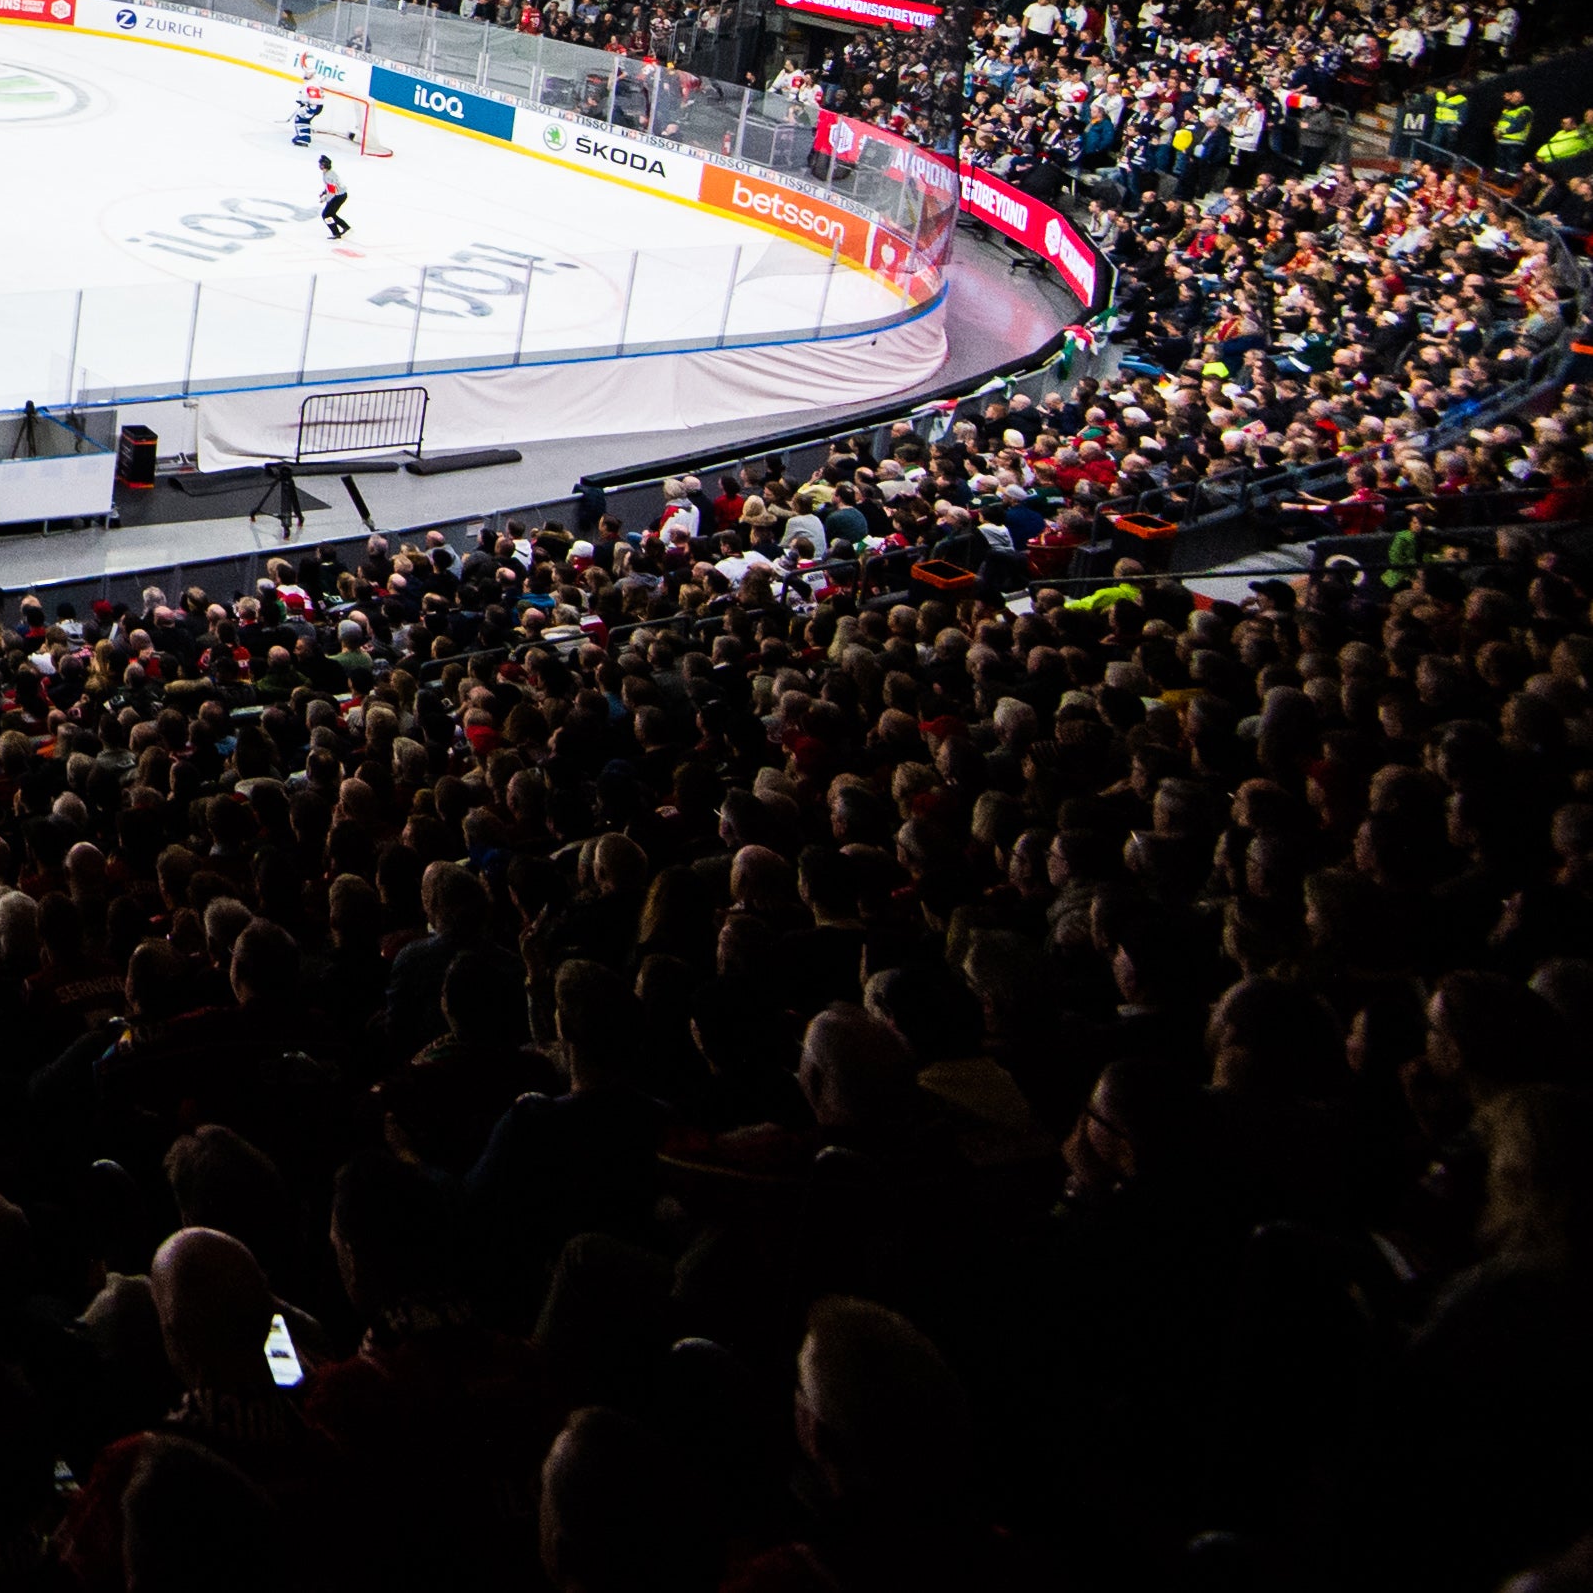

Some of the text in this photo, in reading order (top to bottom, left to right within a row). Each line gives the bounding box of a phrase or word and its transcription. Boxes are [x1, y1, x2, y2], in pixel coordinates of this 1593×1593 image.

[155, 2, 191, 15] TISSOT
[212, 12, 243, 26] TISSOT
[145, 17, 204, 39] ZURICH
[354, 49, 386, 66] TISSOT
[404, 67, 439, 82] TISSOT
[458, 81, 495, 98] TISSOT
[414, 84, 465, 119] iLOQ
[515, 97, 553, 116] TISSOT
[574, 114, 616, 134] TISSOT
[1401, 111, 1426, 132] M
[636, 131, 683, 154] TISSOT
[575, 135, 666, 179] ŠKODA
[707, 153, 754, 174] TISSOT
[778, 172, 820, 195] TISSOT
[731, 179, 845, 244] betsson
[837, 196, 876, 219] TISSOT
